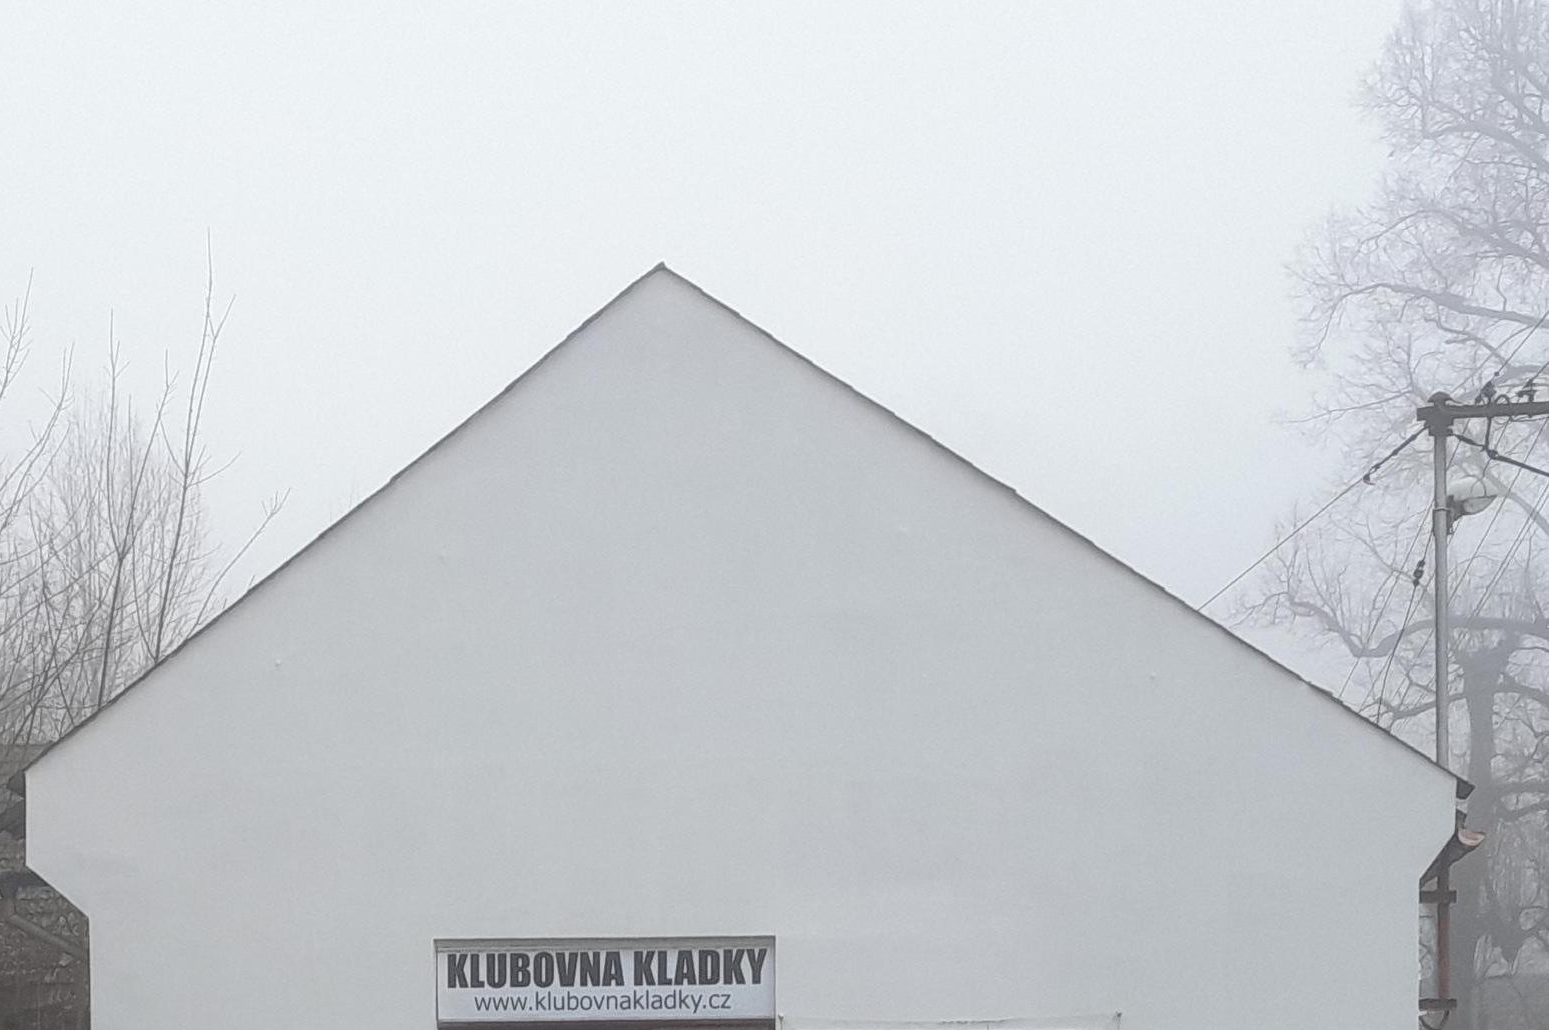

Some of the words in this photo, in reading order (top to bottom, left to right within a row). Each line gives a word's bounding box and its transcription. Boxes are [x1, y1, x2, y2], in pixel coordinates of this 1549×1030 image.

[447, 950, 625, 988] KLUBOVNA
[634, 948, 767, 986] KLADKY
[474, 989, 731, 1013] www.klubovnakladky.cz
